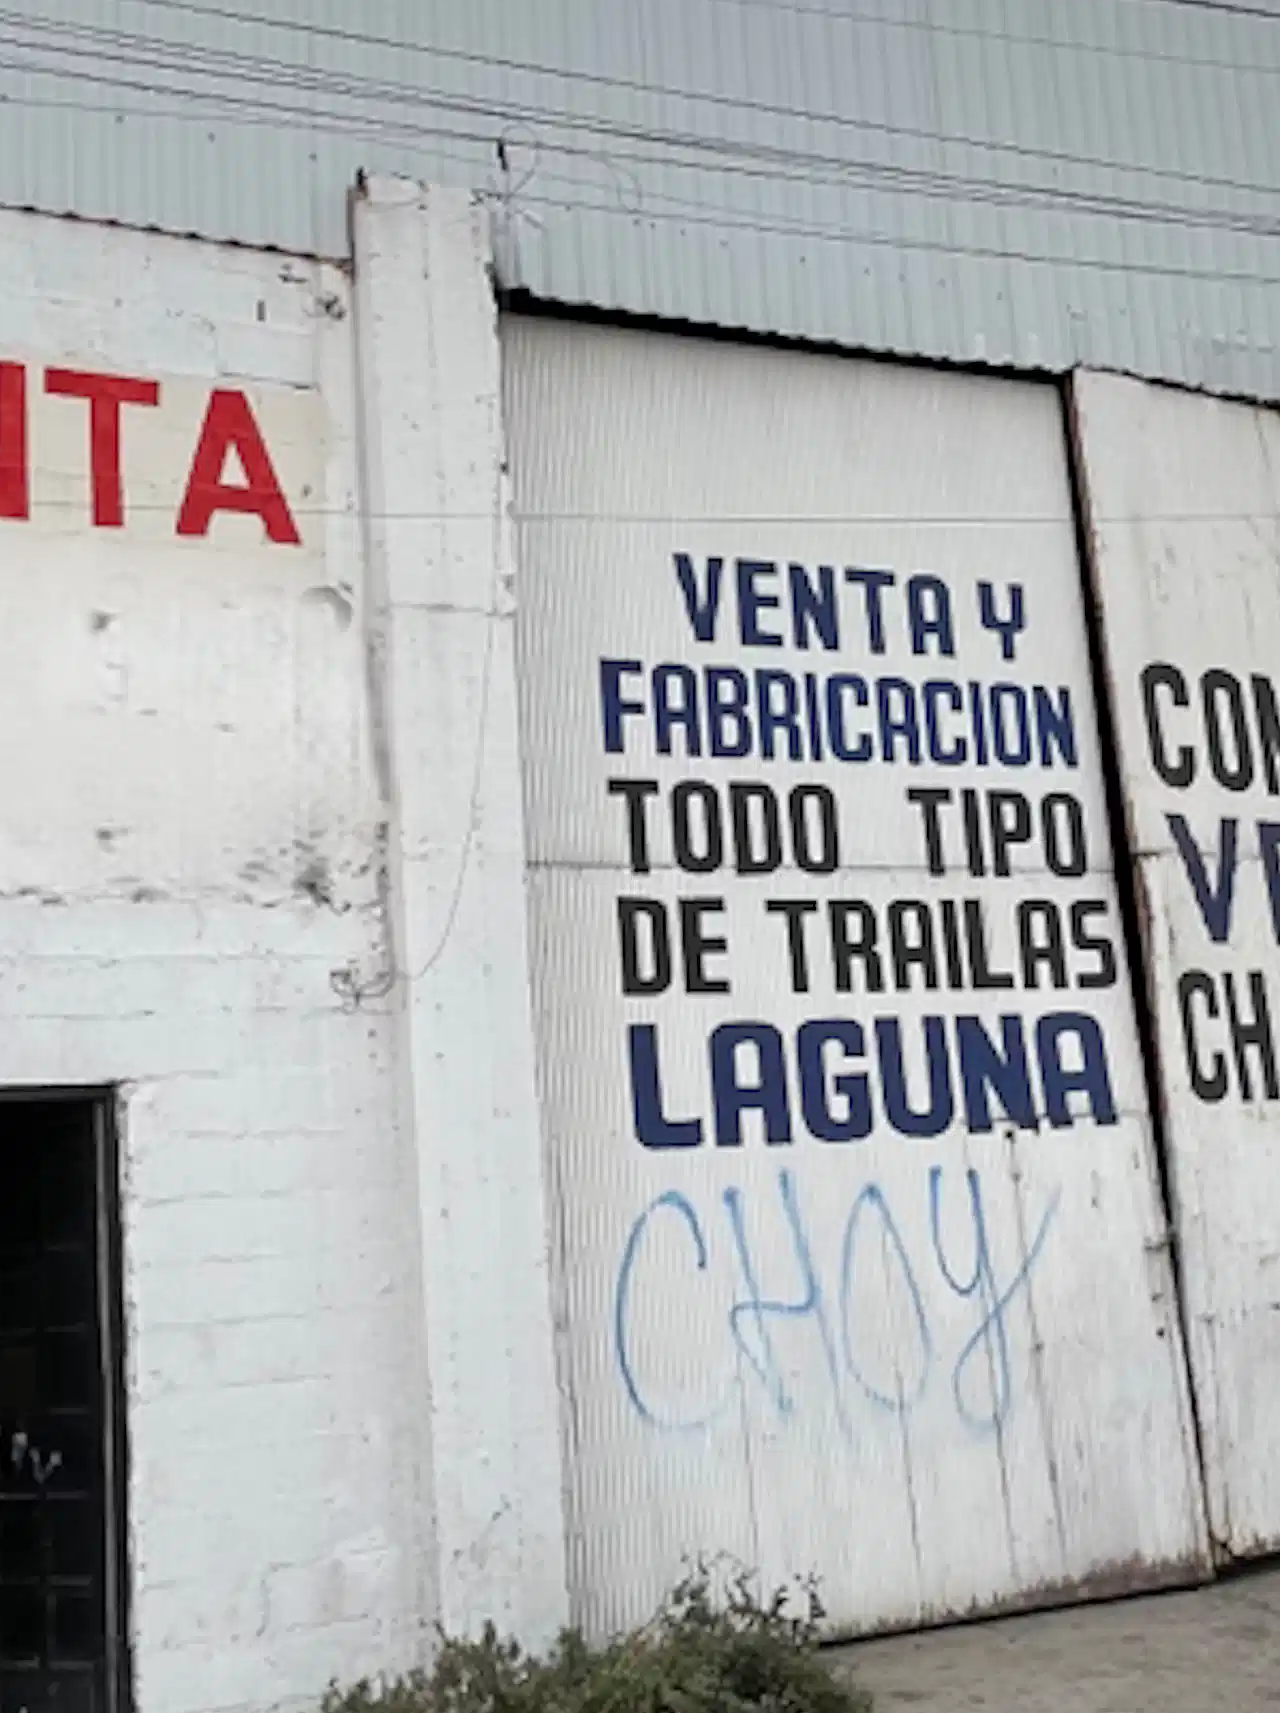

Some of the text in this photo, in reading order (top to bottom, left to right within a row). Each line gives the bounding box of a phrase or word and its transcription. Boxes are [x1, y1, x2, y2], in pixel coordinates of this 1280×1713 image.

[672, 553, 1027, 660] VENTA Y
[600, 657, 1079, 768] FABRICACION
[608, 779, 1087, 877] TODO TIPO
[617, 896, 1116, 996] DE TRAILAS
[627, 1011, 1119, 1149] LAGUNA
